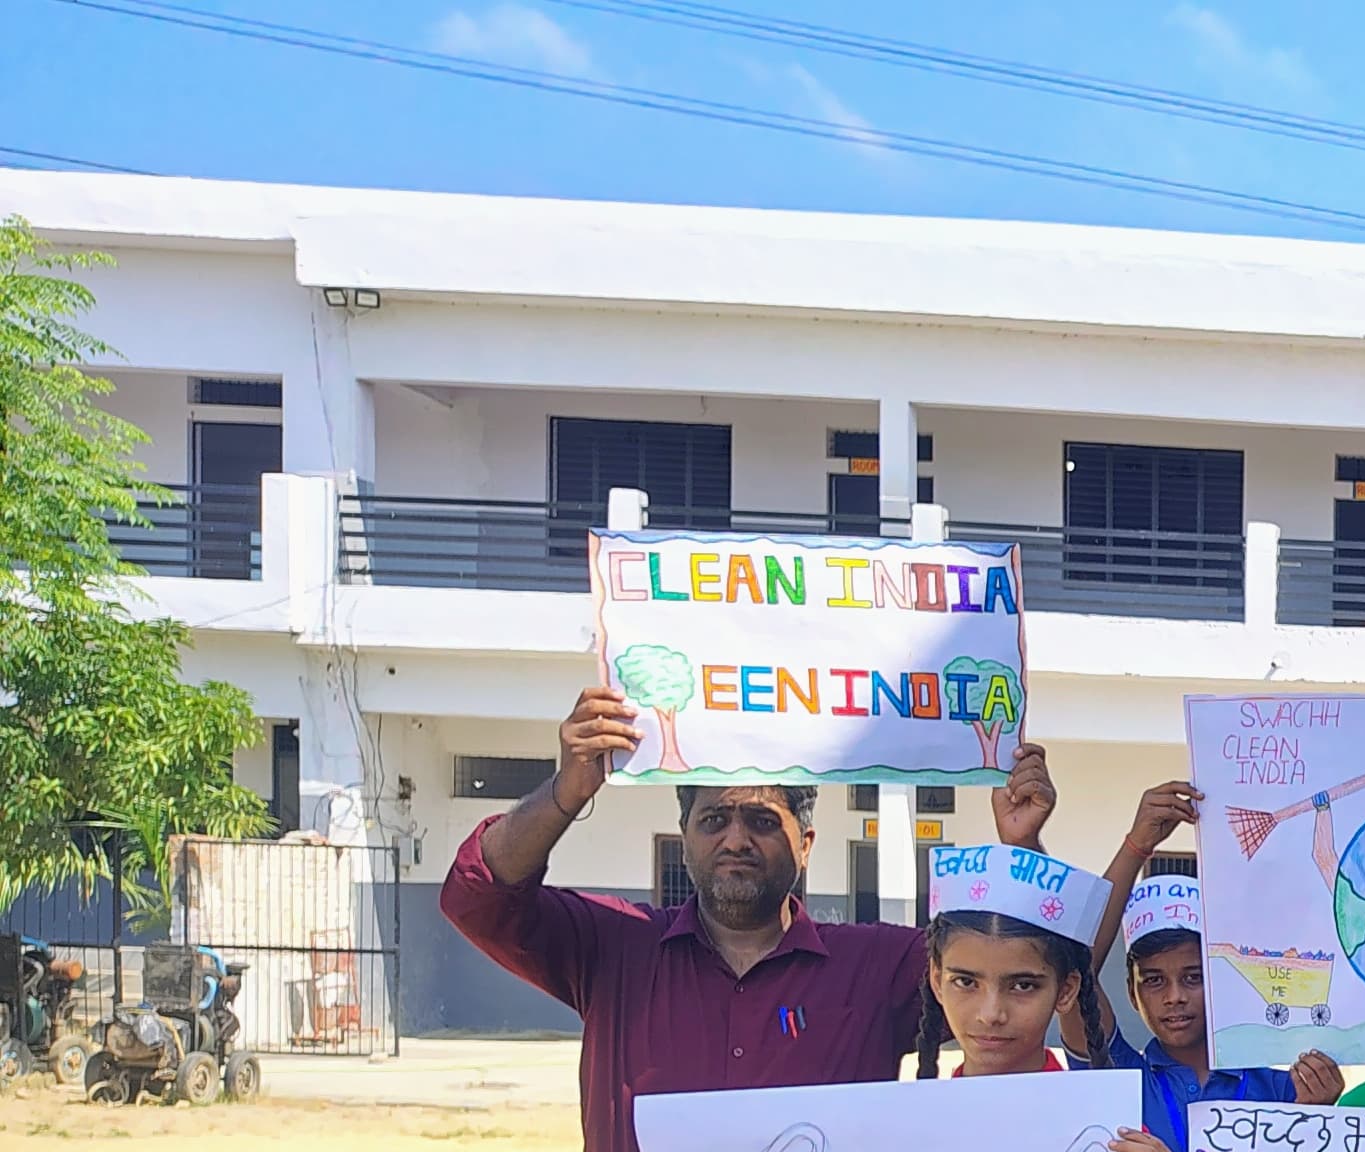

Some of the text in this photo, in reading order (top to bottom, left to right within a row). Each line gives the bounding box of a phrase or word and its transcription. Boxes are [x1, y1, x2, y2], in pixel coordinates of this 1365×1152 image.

[609, 552, 1018, 614] CLEAN INDIA
[702, 664, 1016, 722] EEN INDIA
[1240, 701, 1340, 729] SWACHH
[1223, 735, 1299, 760] CLEAN
[1235, 759, 1306, 785] INDIA
[1010, 848, 1077, 893] भारत
[1268, 966, 1292, 980] USE
[1272, 986, 1287, 997] ME
